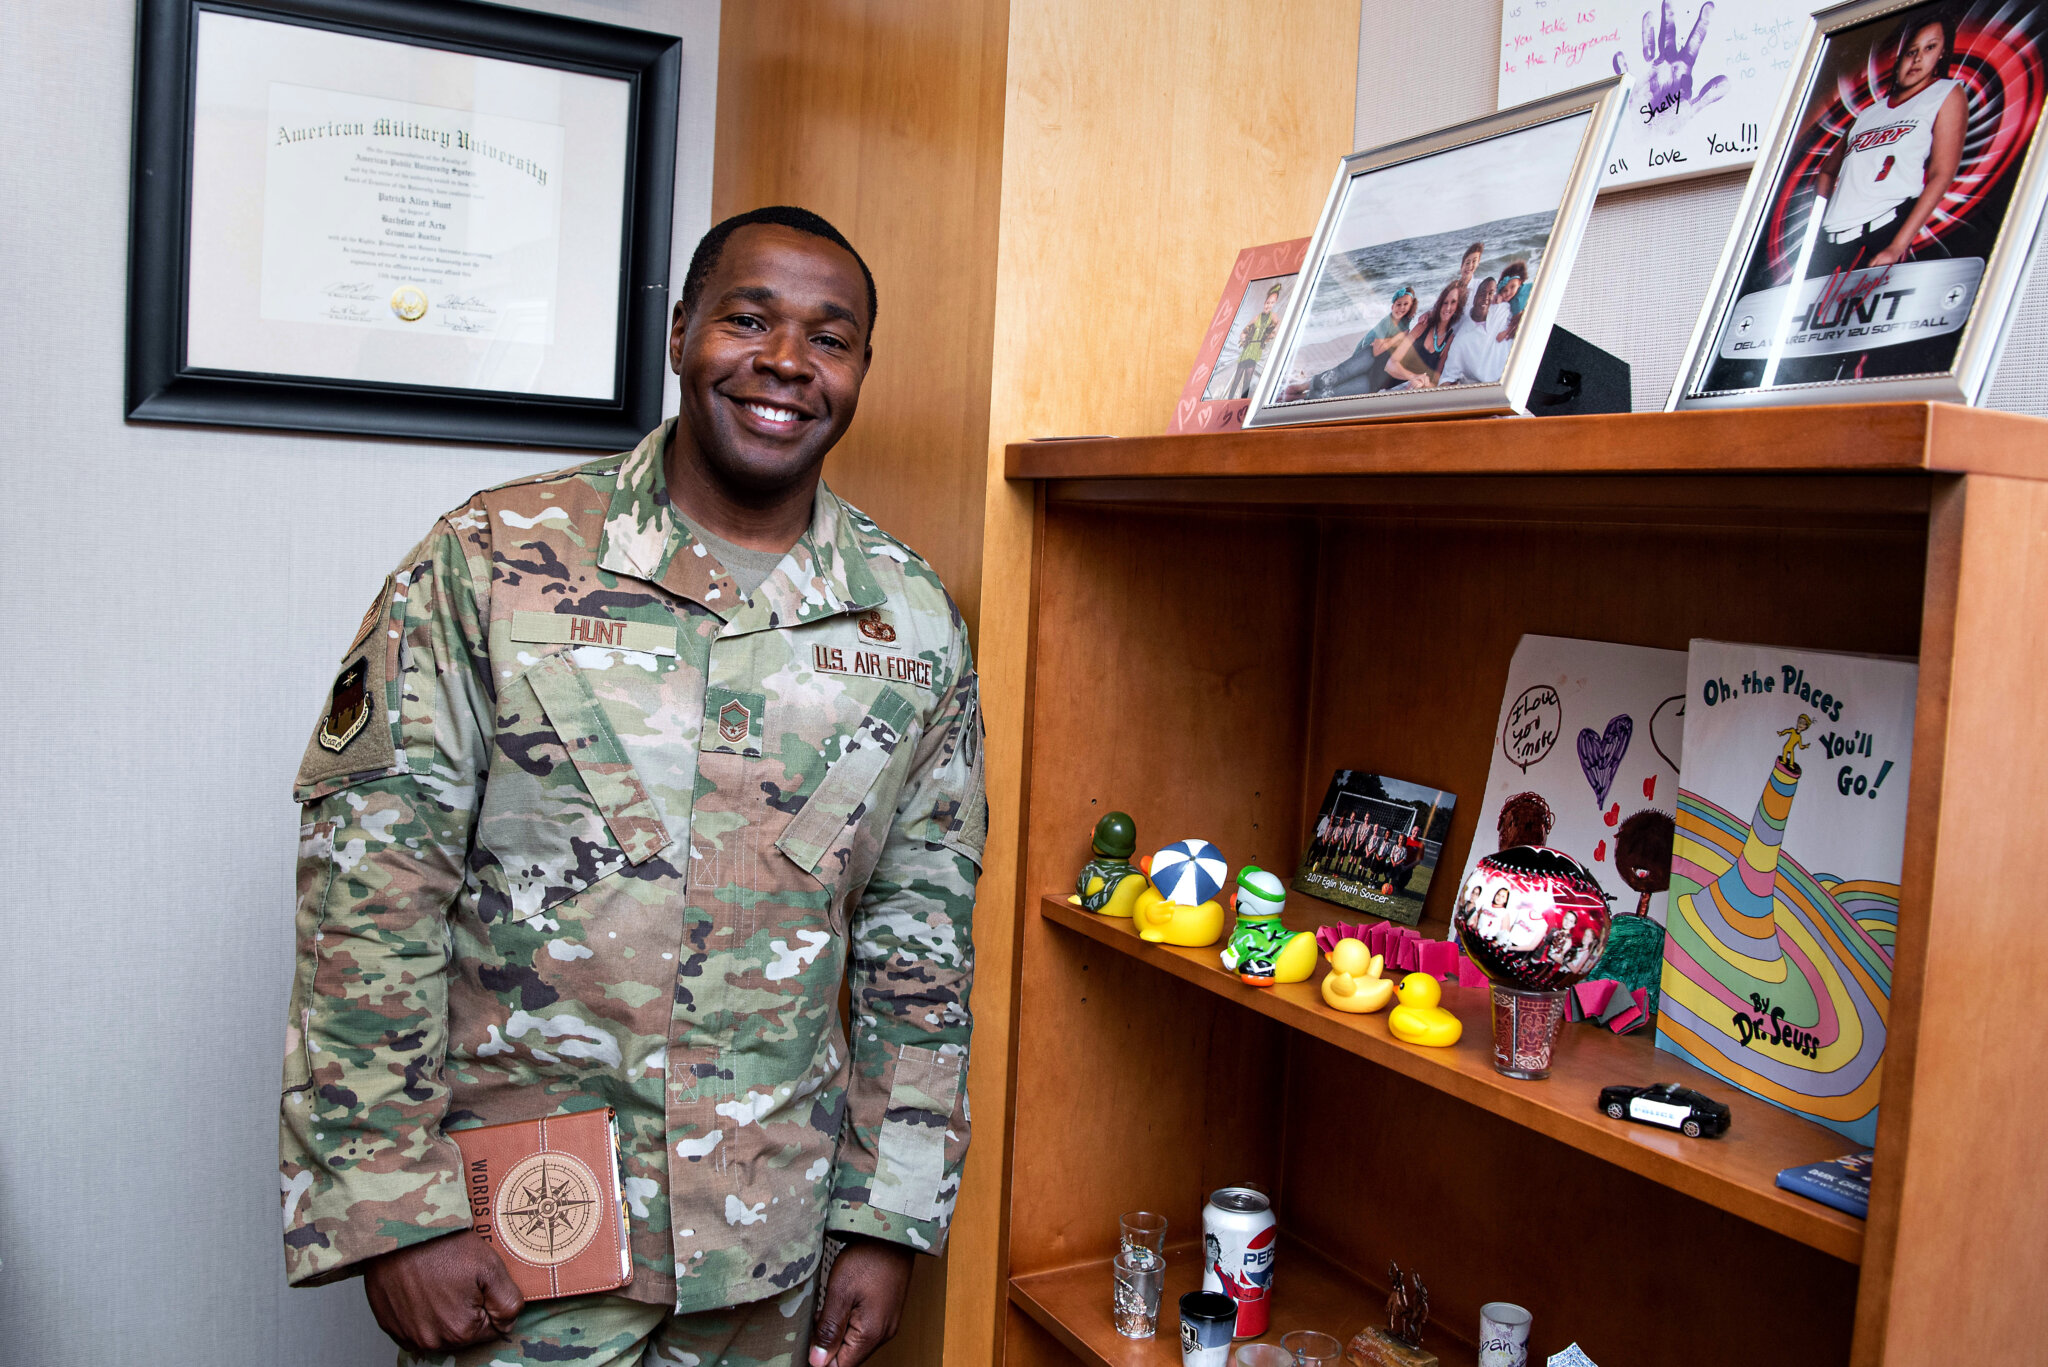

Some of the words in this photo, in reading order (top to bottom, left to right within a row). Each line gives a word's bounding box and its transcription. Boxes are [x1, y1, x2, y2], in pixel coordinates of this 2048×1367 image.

[1539, 17, 1568, 36] take
[1577, 9, 1596, 24] us
[1525, 52, 1547, 70] the
[1640, 91, 1682, 124] Shelly
[276, 120, 364, 146] American
[373, 118, 451, 149] Military
[457, 130, 548, 186] University
[1609, 159, 1629, 175] all
[1649, 148, 1688, 167] Love
[1707, 123, 1759, 155] You!!!
[1846, 127, 1911, 154] FURY
[378, 192, 406, 204] Patrick
[409, 196, 430, 208] Allen
[432, 199, 452, 209] Hunt
[428, 220, 446, 231] Arts
[1734, 333, 1806, 351] DELAARE
[1808, 329, 1845, 343] FURY
[1847, 326, 1871, 338] 12U
[571, 617, 628, 646] HUNT
[815, 645, 847, 672] U.S.
[854, 651, 882, 676] AIR
[887, 655, 932, 686] FORCE
[1703, 677, 1738, 707] Oh,
[1741, 669, 1776, 695] the
[1782, 665, 1844, 722] Places
[1818, 729, 1873, 760] You'll
[1837, 759, 1895, 800] Go!
[1321, 876, 1337, 890] Eglin
[1338, 880, 1358, 896] Youth
[1359, 887, 1389, 904] Soccer
[1749, 992, 1770, 1015] By
[1732, 1012, 1767, 1047] Dr.
[1769, 1006, 1820, 1060] Seuss
[471, 1158, 490, 1222] WORDS
[1243, 1247, 1275, 1266] PEP
